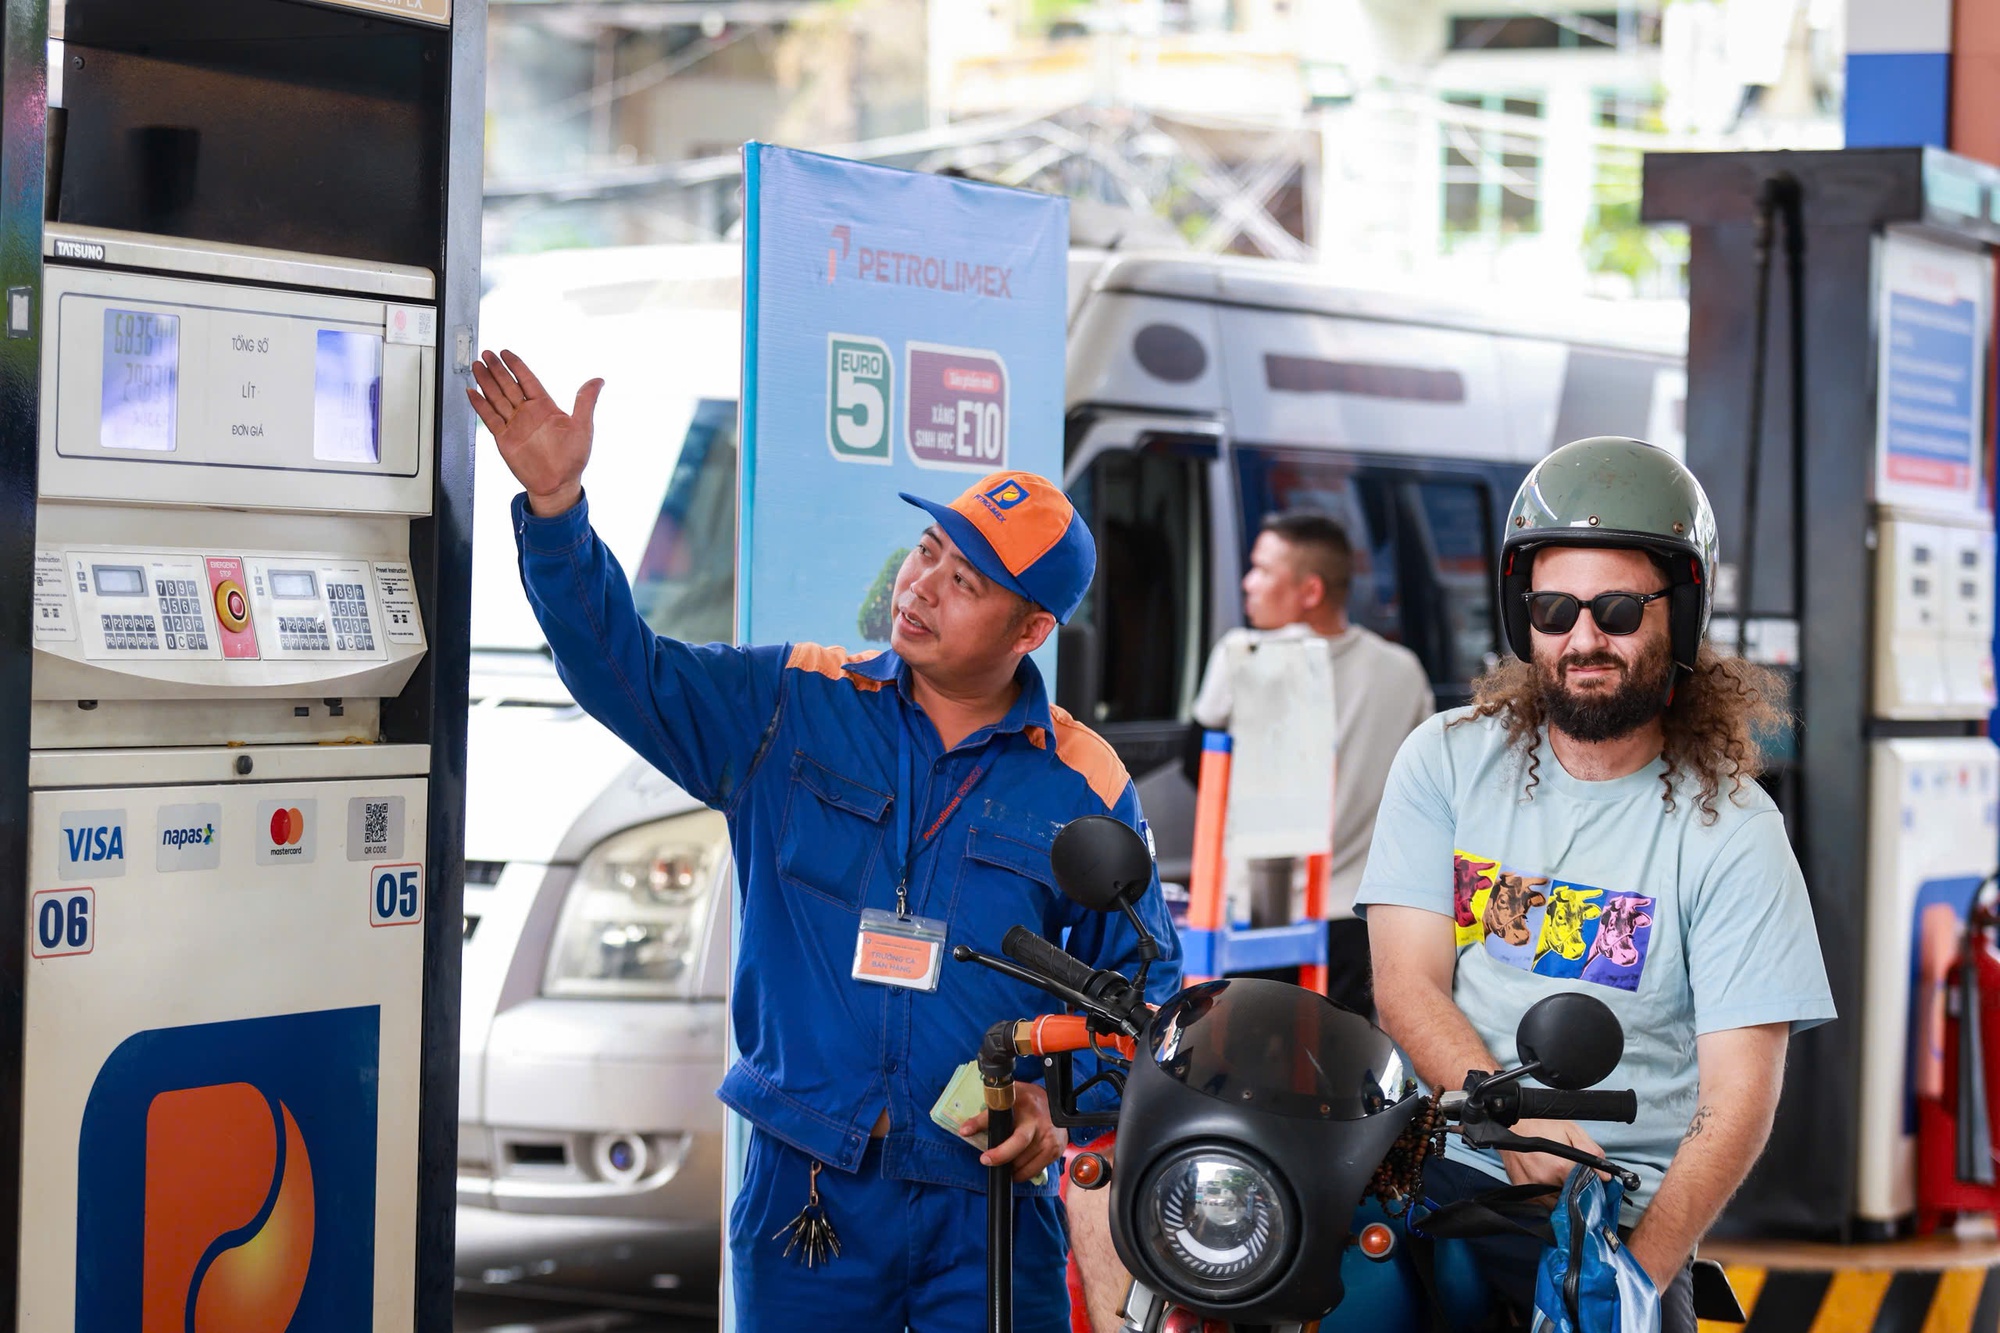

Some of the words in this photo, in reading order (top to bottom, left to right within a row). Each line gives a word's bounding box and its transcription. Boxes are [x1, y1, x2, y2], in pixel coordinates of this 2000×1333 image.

[57, 241, 103, 260] TATSUNO
[858, 248, 1012, 299] PETROLIMEX
[258, 338, 270, 353] SỐ
[841, 353, 880, 375] EURO
[242, 381, 256, 399] LÍT
[837, 374, 884, 449] 5
[250, 424, 264, 437] GIÁ
[957, 400, 1001, 460] E10
[915, 430, 936, 448] SINH
[157, 582, 163, 594] 7
[168, 582, 174, 594] 8
[179, 582, 185, 594] 9
[327, 586, 333, 597] 7
[337, 586, 343, 597] 8
[347, 586, 353, 597] 9
[162, 601, 168, 612] 4
[172, 601, 178, 612] 5
[182, 601, 188, 612] 6
[331, 604, 337, 614] 4
[341, 604, 346, 614] 5
[350, 604, 356, 614] 6
[165, 618, 170, 630] 1
[176, 618, 181, 630] 2
[186, 618, 192, 630] 3
[334, 621, 340, 631] 1
[344, 621, 350, 631] 2
[353, 621, 359, 631] 3
[168, 636, 174, 648] 0
[179, 636, 185, 648] C
[348, 638, 354, 648] C
[923, 796, 962, 840] Petrolimex
[63, 826, 124, 862] VISA
[162, 828, 202, 850] napas
[270, 846, 302, 856] mastercard
[364, 846, 372, 854] QR
[376, 872, 418, 918] 05
[39, 896, 88, 948] 06
